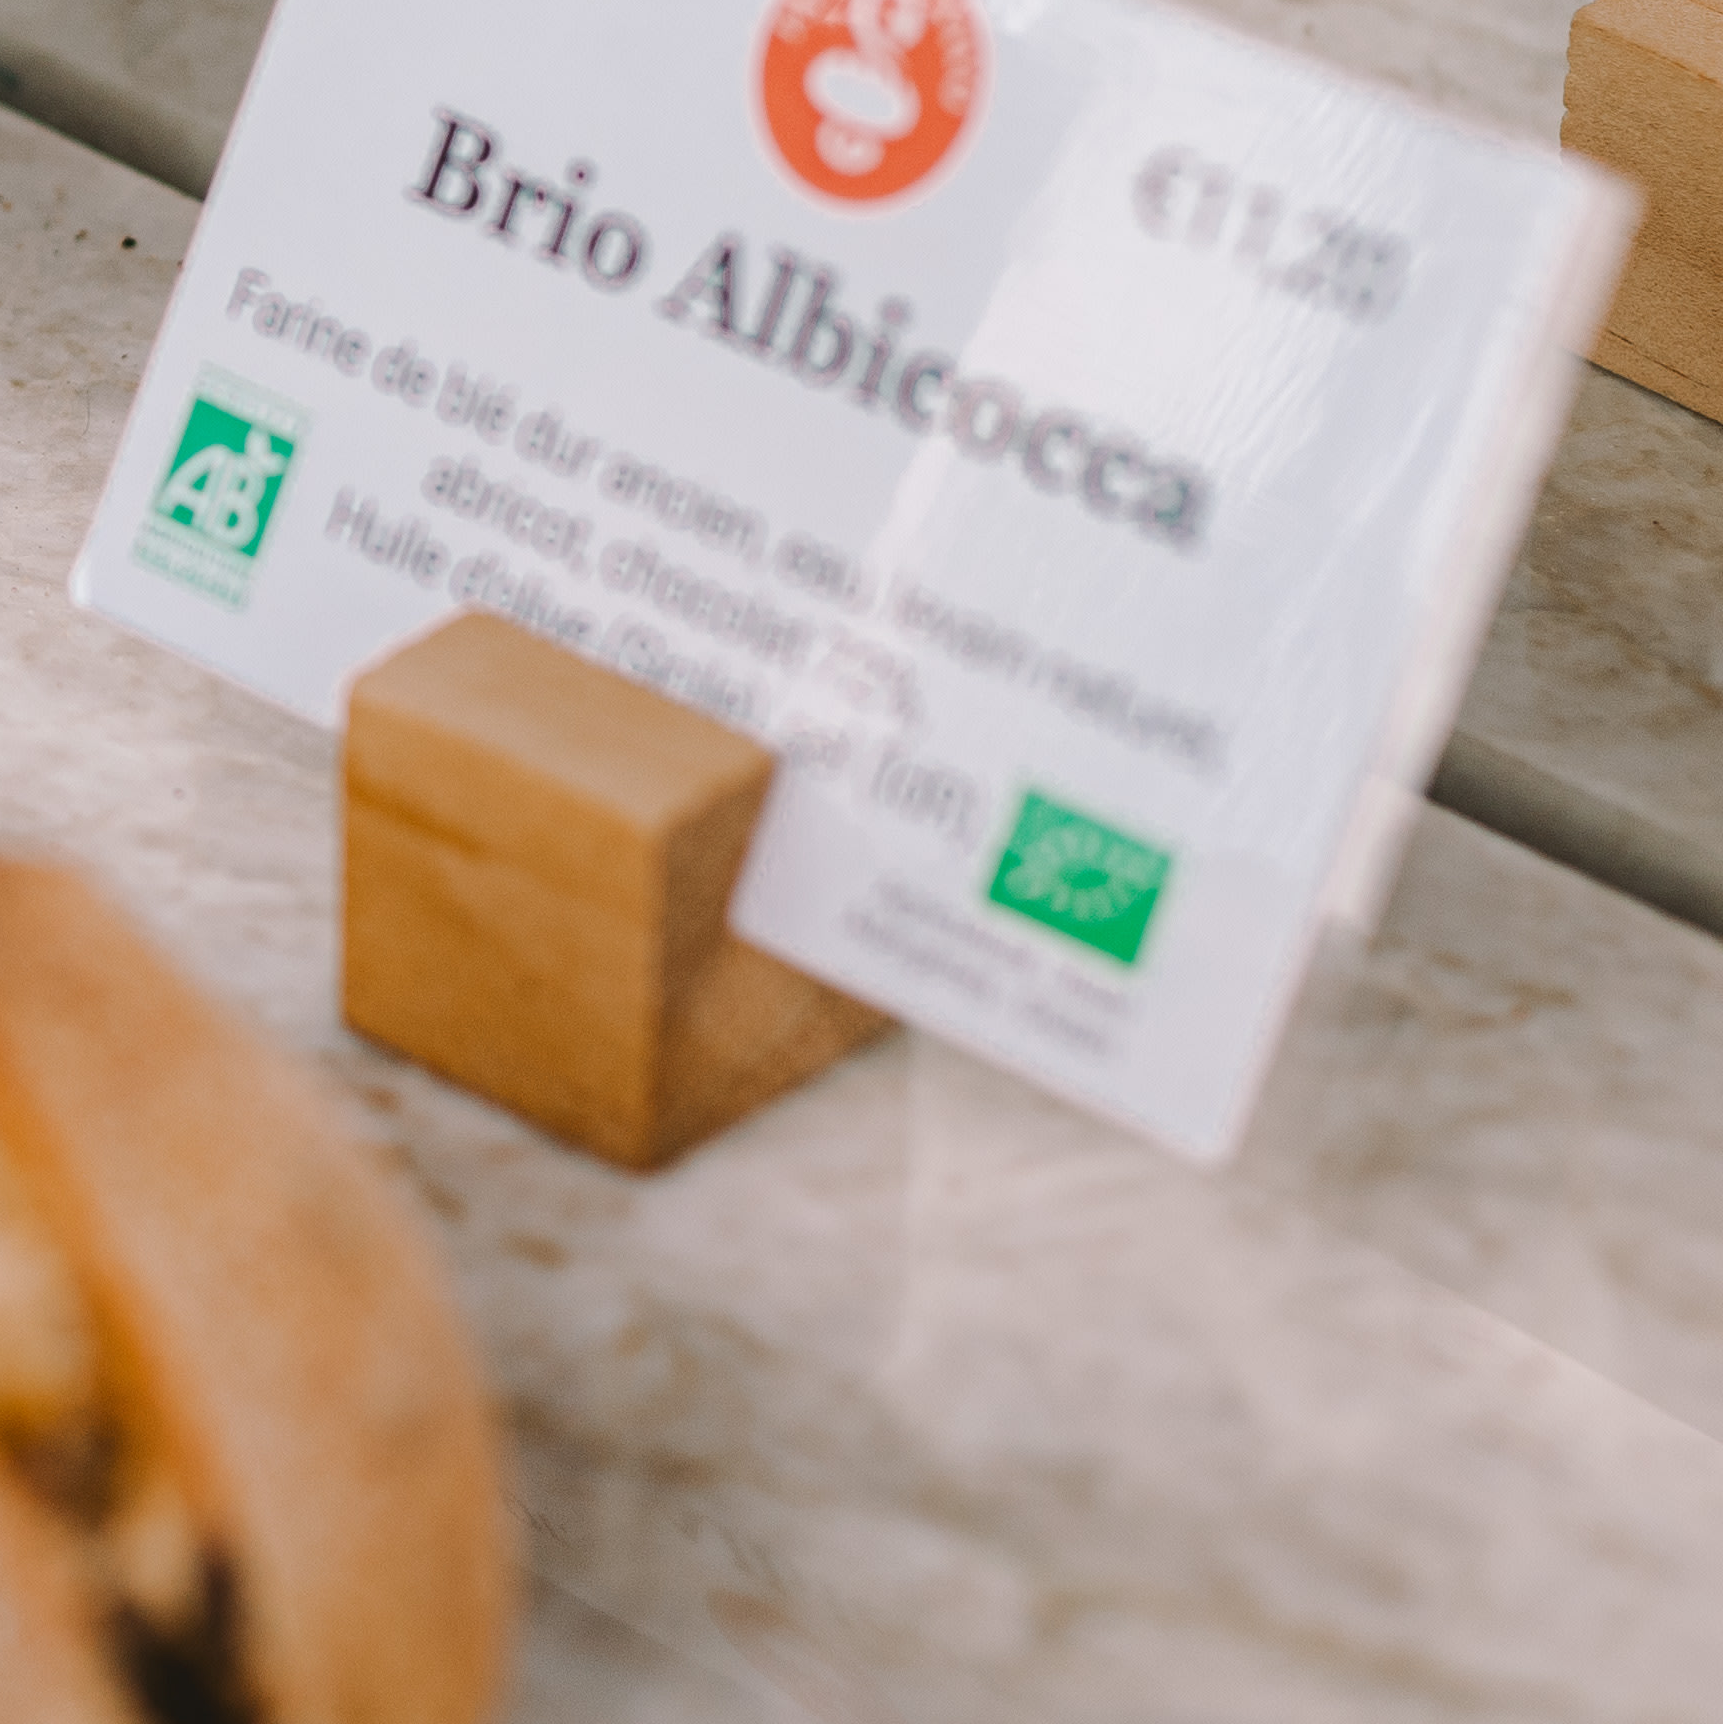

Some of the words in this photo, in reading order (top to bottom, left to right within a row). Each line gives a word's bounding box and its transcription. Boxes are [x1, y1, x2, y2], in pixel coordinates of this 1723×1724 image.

[225, 267, 371, 376] Farine
[371, 340, 439, 407] de
[514, 406, 600, 477] dur
[404, 105, 648, 295] Brio
[655, 228, 1212, 557] Albicocca
[155, 443, 267, 555] AB
[324, 485, 450, 588] Huile
